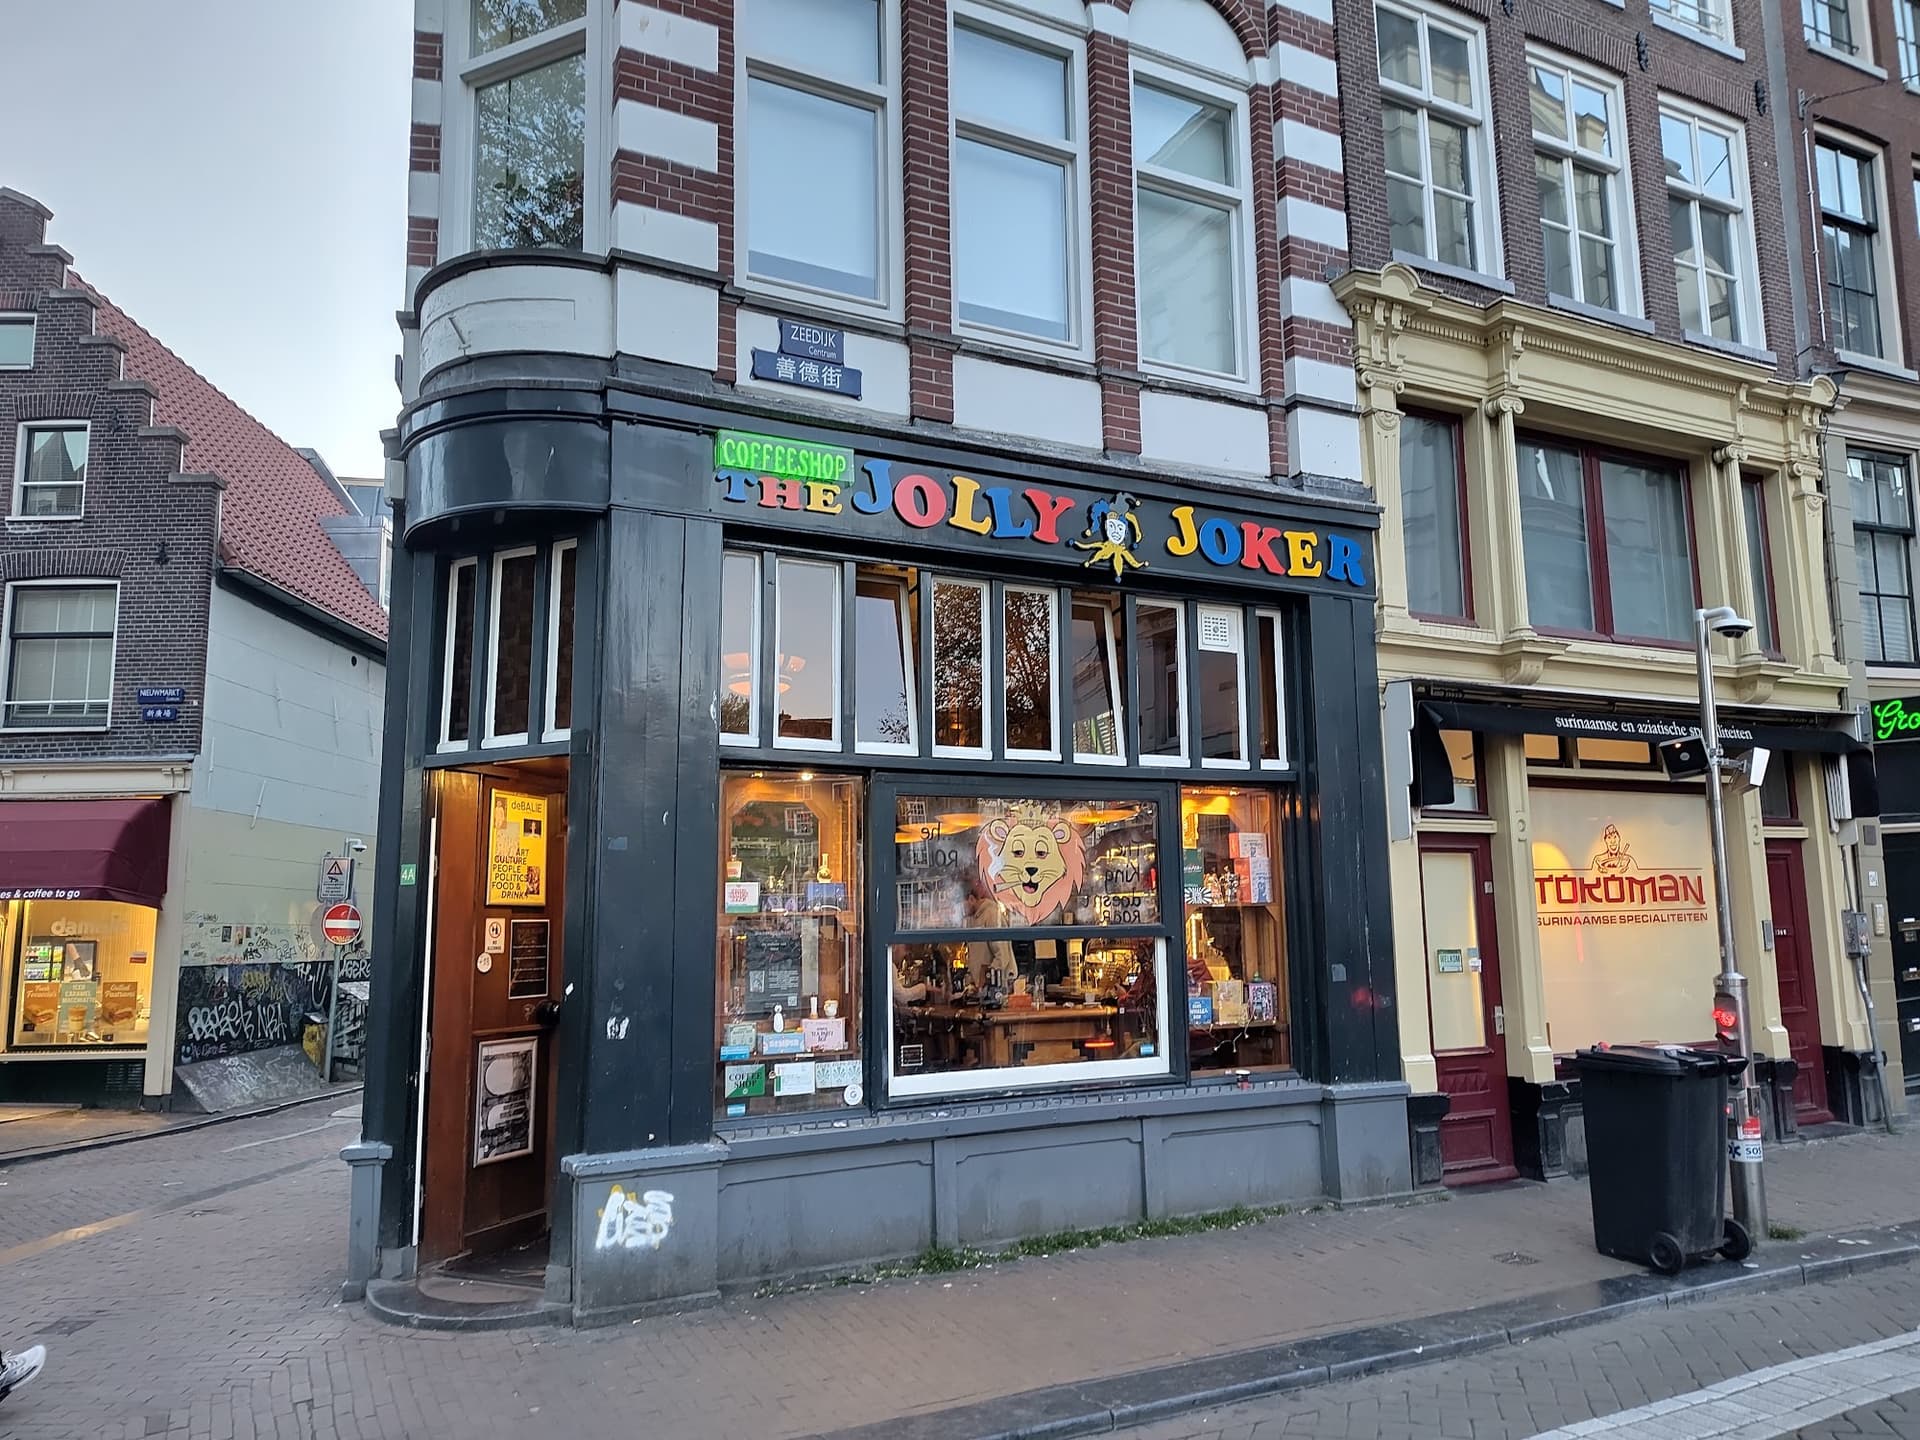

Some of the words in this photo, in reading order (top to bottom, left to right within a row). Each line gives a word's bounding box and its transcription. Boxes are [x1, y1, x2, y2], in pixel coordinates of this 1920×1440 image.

[790, 325, 836, 348] ZEEDIJK
[808, 345, 837, 359] Centrum
[776, 356, 842, 389] 善德街
[722, 438, 846, 481] COFFEESHOP
[717, 470, 843, 514] THE
[853, 459, 1077, 544] JOLLY
[1166, 505, 1367, 587] JOKER
[140, 688, 180, 697] NIEUWMARKT
[1555, 713, 1619, 732] surinaamse
[1620, 721, 1636, 733] en
[1637, 719, 1687, 736] aziatische
[516, 848, 530, 857] ART
[494, 855, 527, 866] CULTURE
[401, 869, 416, 881] 4A
[493, 864, 521, 874] PEOPLE
[495, 872, 529, 883] POLITICS
[492, 881, 515, 891] FOOD
[516, 881, 521, 890] &
[1535, 874, 1706, 905] TOKOMAN
[0, 891, 12, 899] es
[14, 889, 21, 898] &
[23, 888, 53, 899] coffee
[55, 889, 65, 898] to
[67, 890, 80, 900] go
[1619, 912, 1708, 924] SPECIALITEITEN
[728, 1071, 762, 1082] COFFEE
[733, 1079, 758, 1090] SHOP
